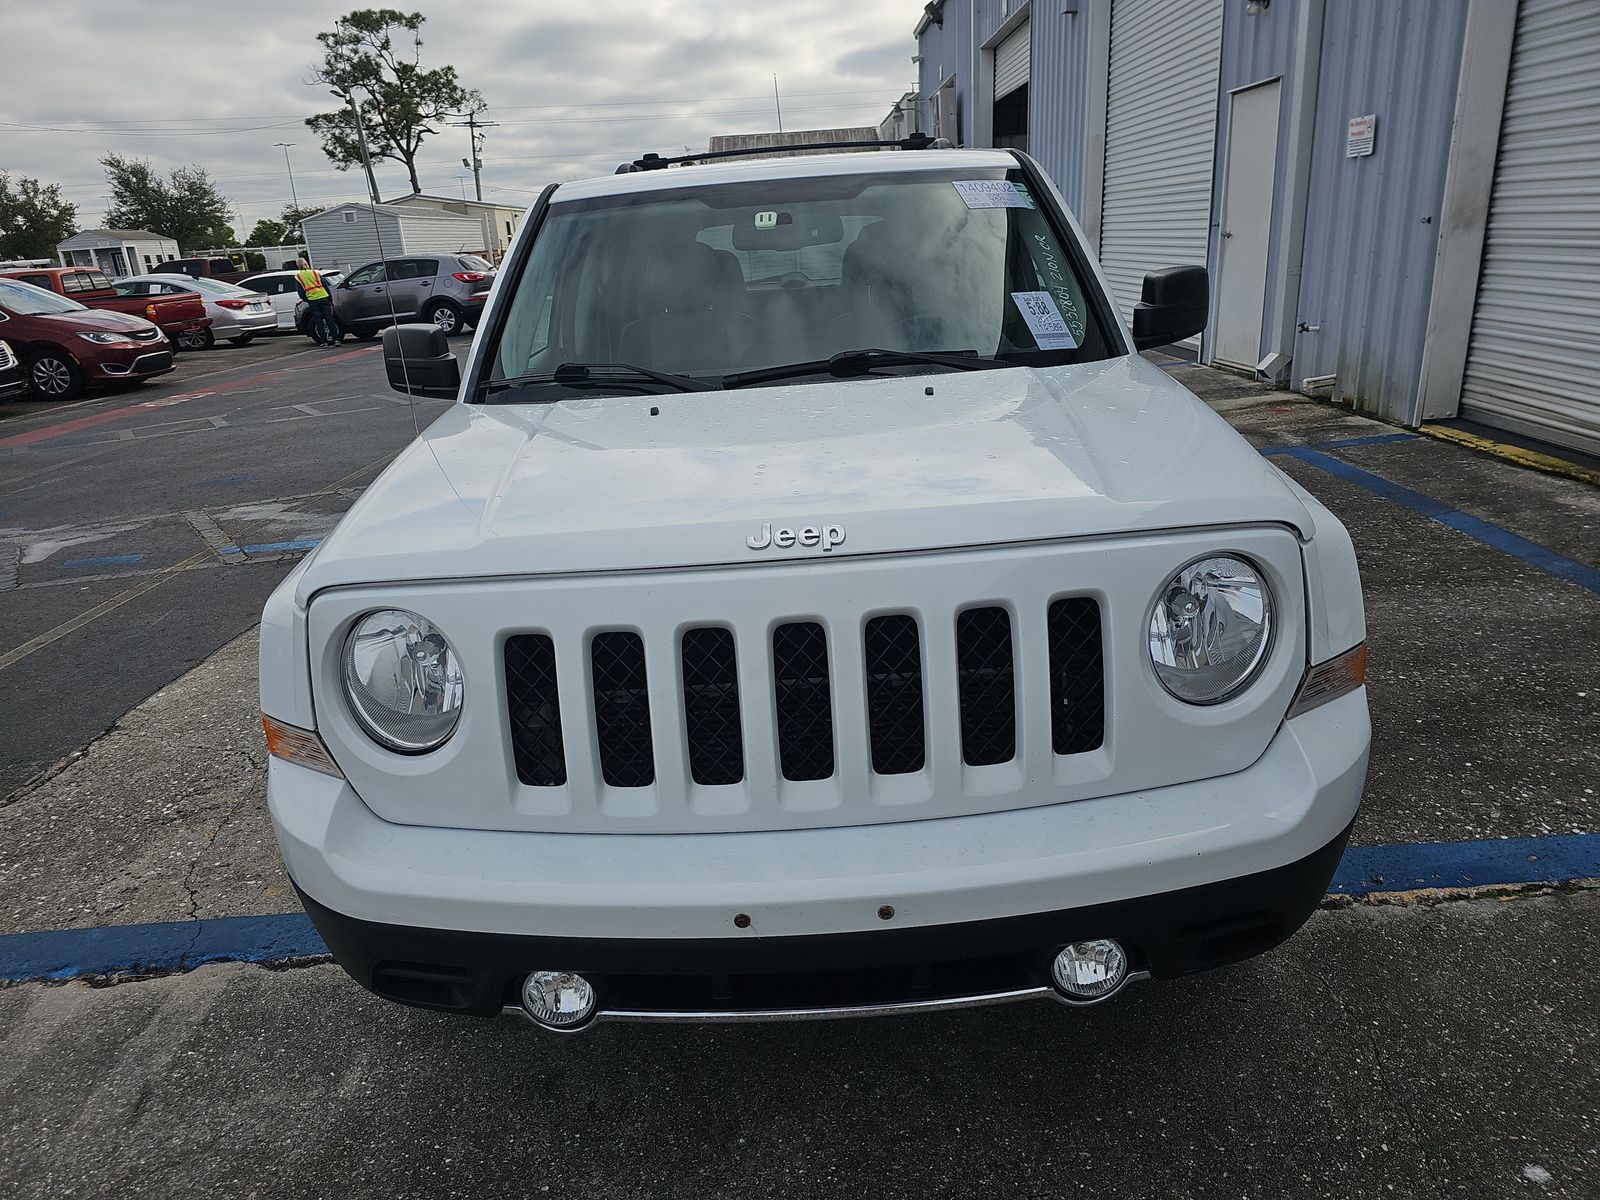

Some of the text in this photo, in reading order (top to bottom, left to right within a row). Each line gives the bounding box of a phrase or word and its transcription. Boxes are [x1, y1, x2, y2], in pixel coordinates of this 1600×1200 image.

[959, 182, 1015, 193] 1409402
[1025, 301, 1051, 316] 5:88
[1054, 285, 1085, 337] 5532804
[745, 521, 847, 553] Jeep
